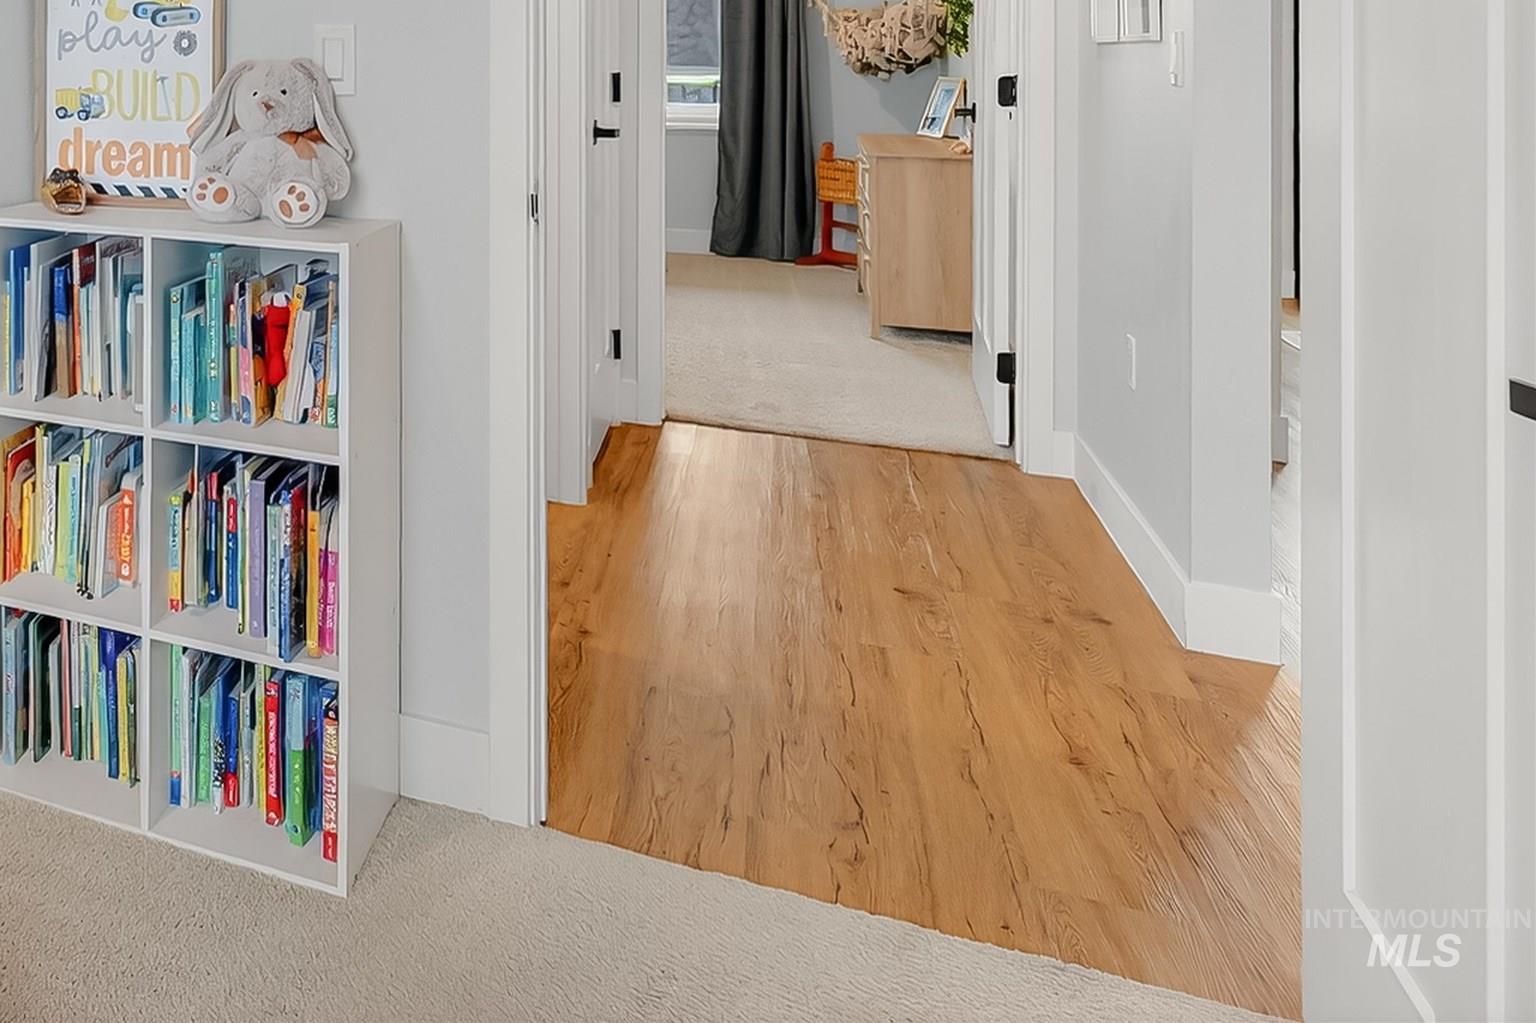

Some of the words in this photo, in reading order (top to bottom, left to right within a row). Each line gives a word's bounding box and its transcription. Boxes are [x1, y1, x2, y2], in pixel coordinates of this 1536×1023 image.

[57, 10, 168, 64] play
[91, 68, 201, 122] BUILD
[57, 127, 192, 181] dream
